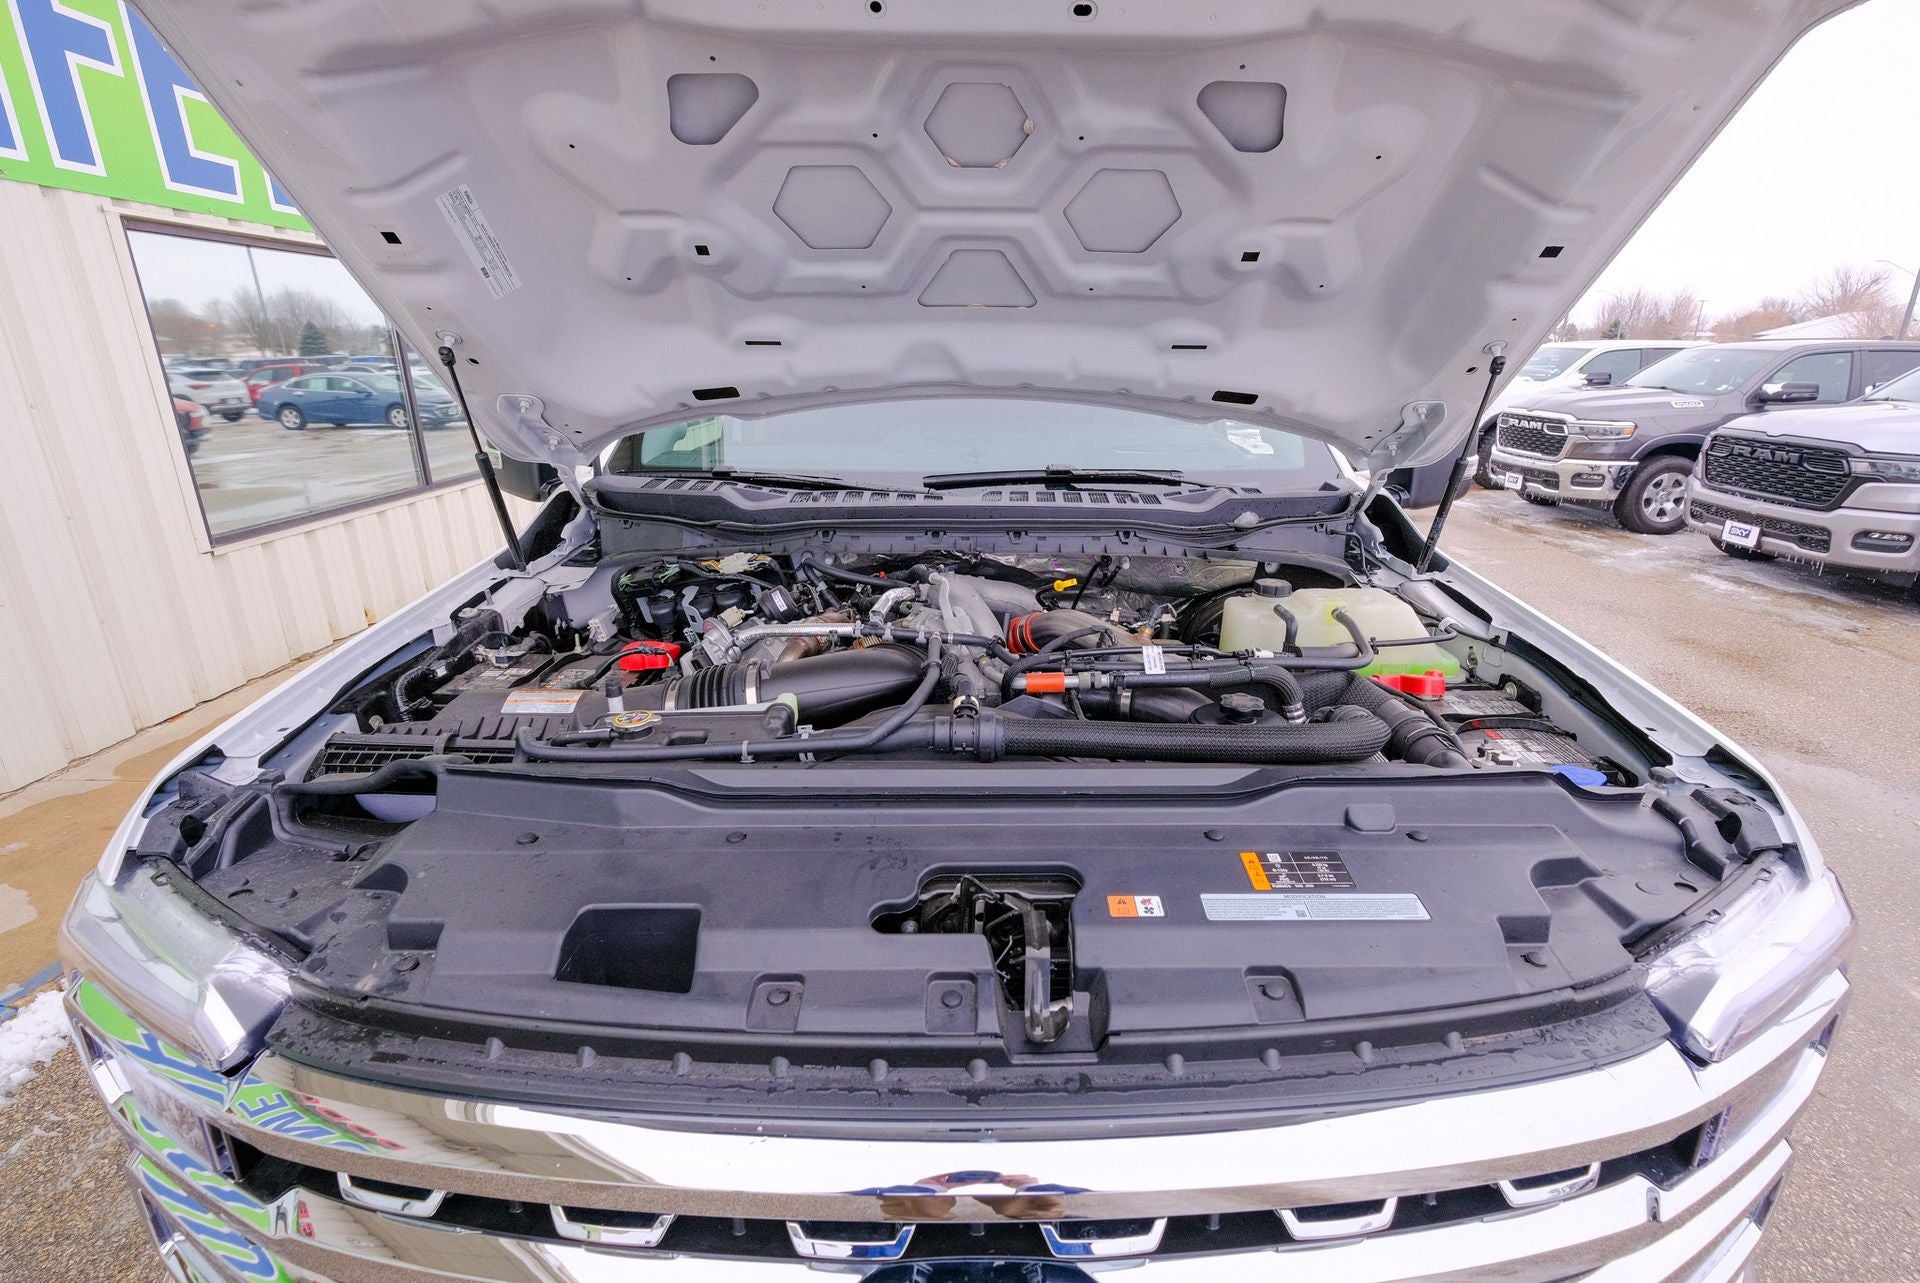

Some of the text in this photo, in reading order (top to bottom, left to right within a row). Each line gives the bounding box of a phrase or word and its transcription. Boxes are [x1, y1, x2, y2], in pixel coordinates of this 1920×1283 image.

[1509, 418, 1543, 430] RAM
[1731, 445, 1801, 464] RAM
[1730, 527, 1749, 537] SKY
